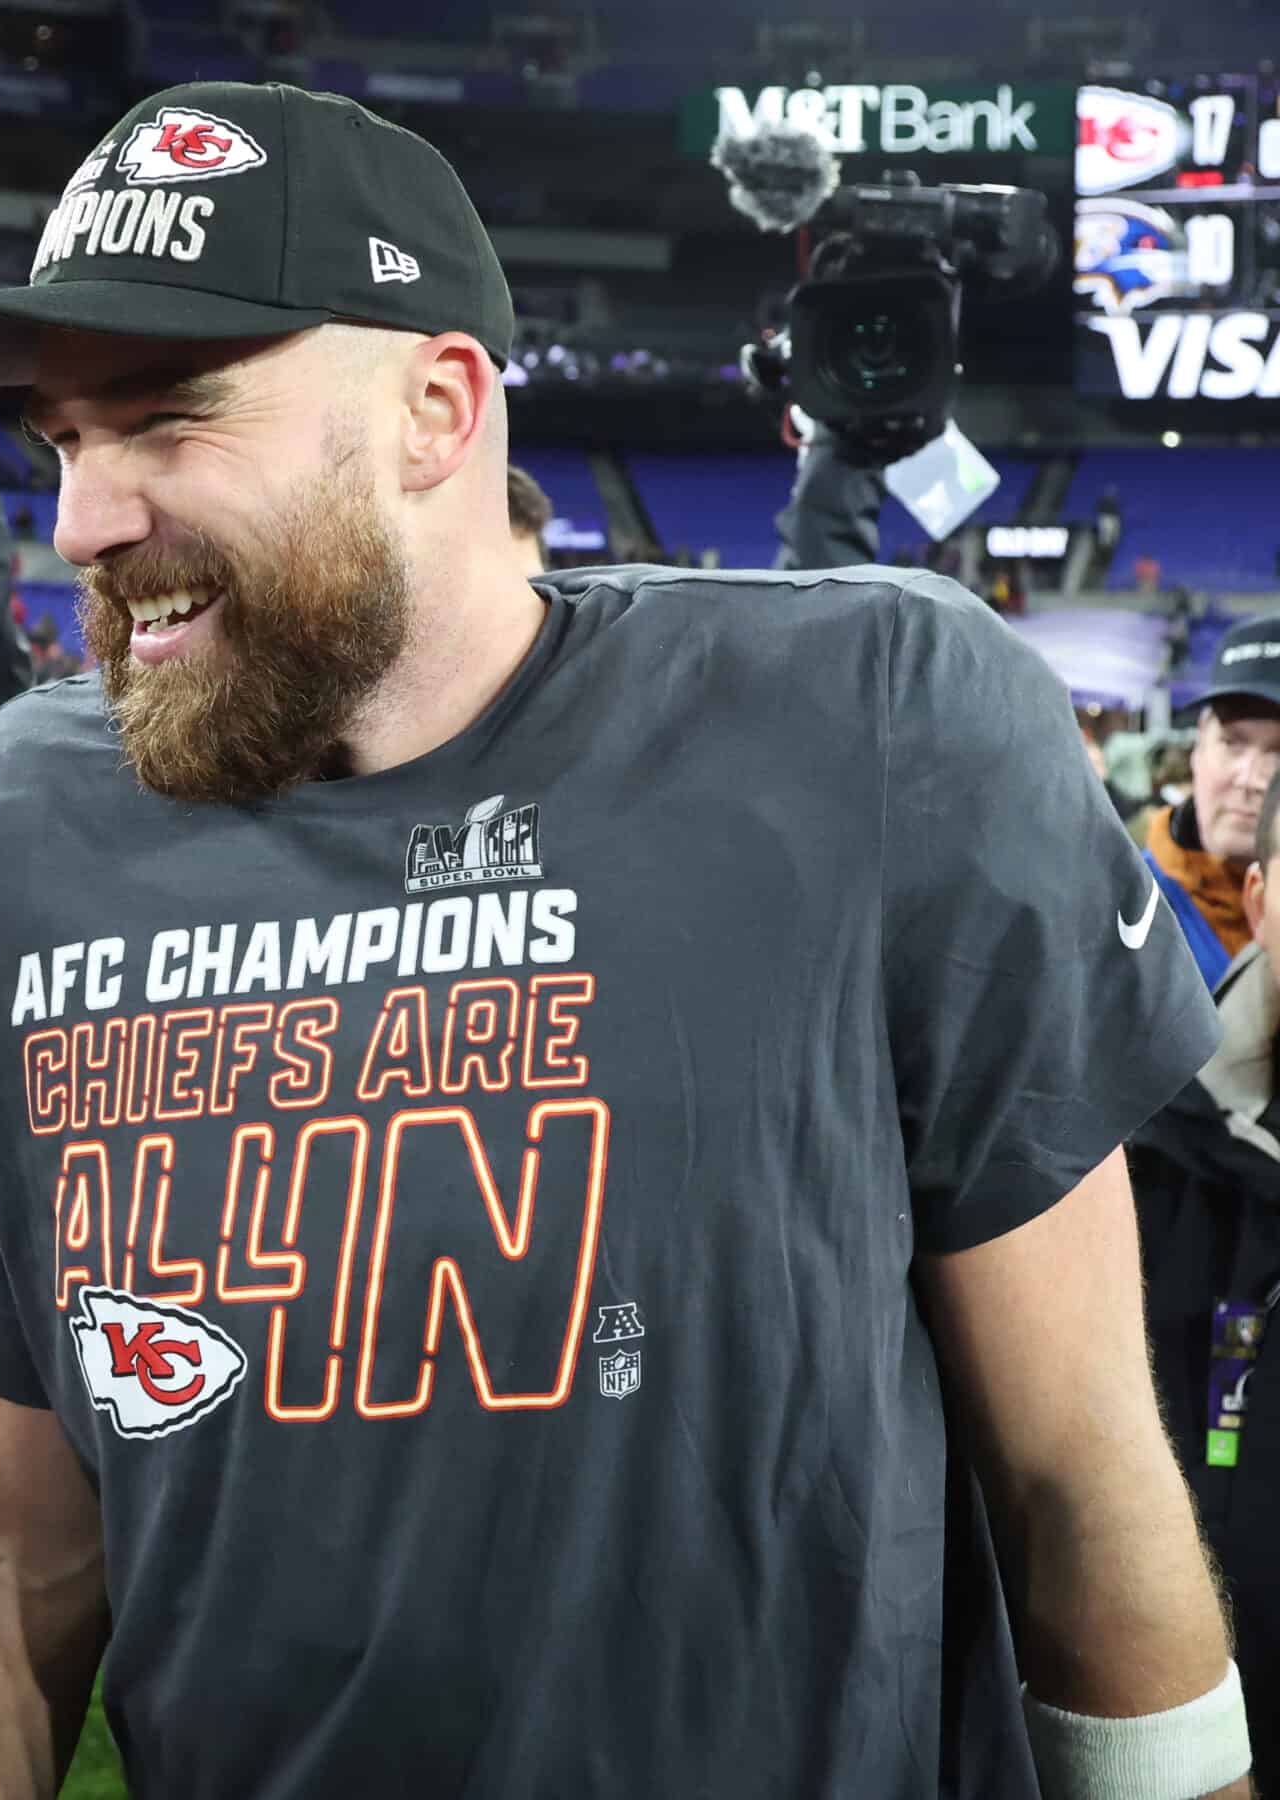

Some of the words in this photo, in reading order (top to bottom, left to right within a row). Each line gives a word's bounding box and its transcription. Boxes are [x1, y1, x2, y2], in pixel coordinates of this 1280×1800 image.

[880, 84, 1038, 152] Bank
[420, 871, 473, 888] SUPER
[482, 866, 531, 878] BOWL
[11, 936, 125, 1026] AFC
[145, 888, 578, 1002] CHAMPIONS
[23, 997, 339, 1134] CHIEFS
[356, 972, 595, 1101] ARE
[54, 1121, 306, 1310] ALL
[264, 1097, 610, 1422] IN
[604, 1368, 638, 1393] NFL
